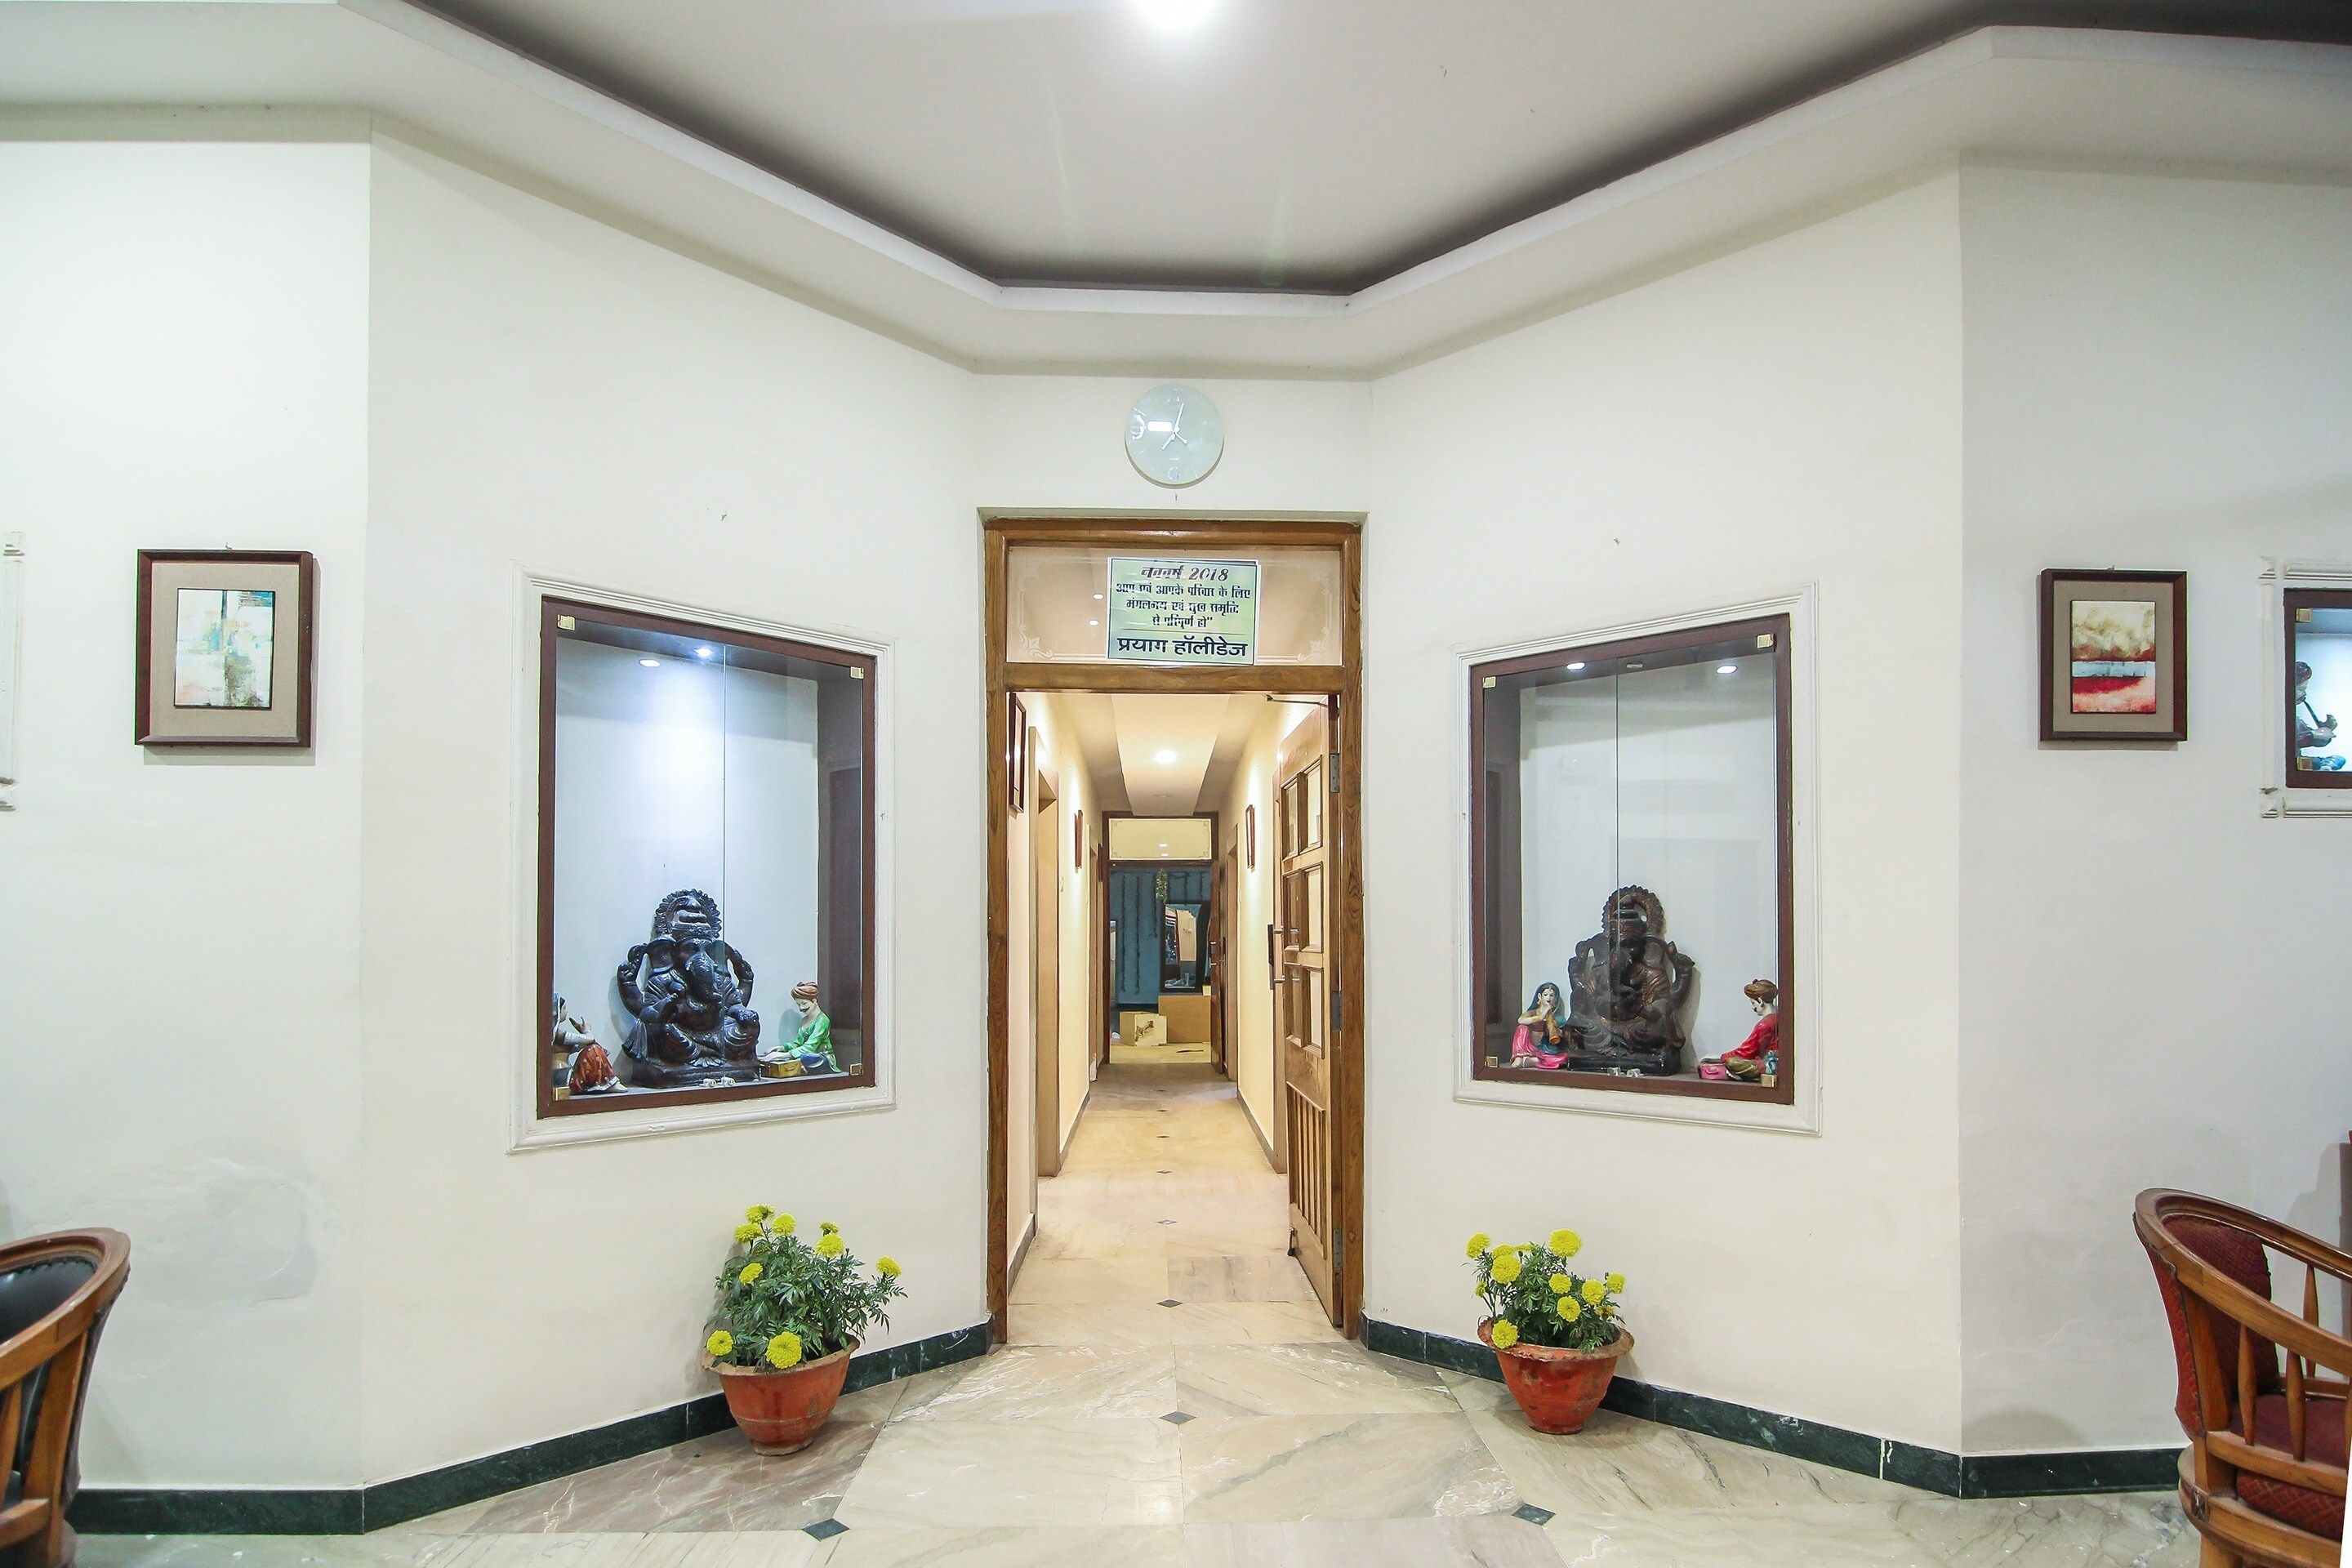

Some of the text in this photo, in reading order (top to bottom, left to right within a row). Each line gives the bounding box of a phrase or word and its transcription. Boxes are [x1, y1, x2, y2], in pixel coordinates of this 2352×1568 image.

[1188, 567, 1229, 581] 2018
[1156, 583, 1183, 595] आपके
[1187, 583, 1215, 597] परिवार
[1218, 586, 1228, 595] के
[1231, 585, 1251, 599] लिए
[1116, 635, 1248, 656] प्रयाग हॉलीडेज
